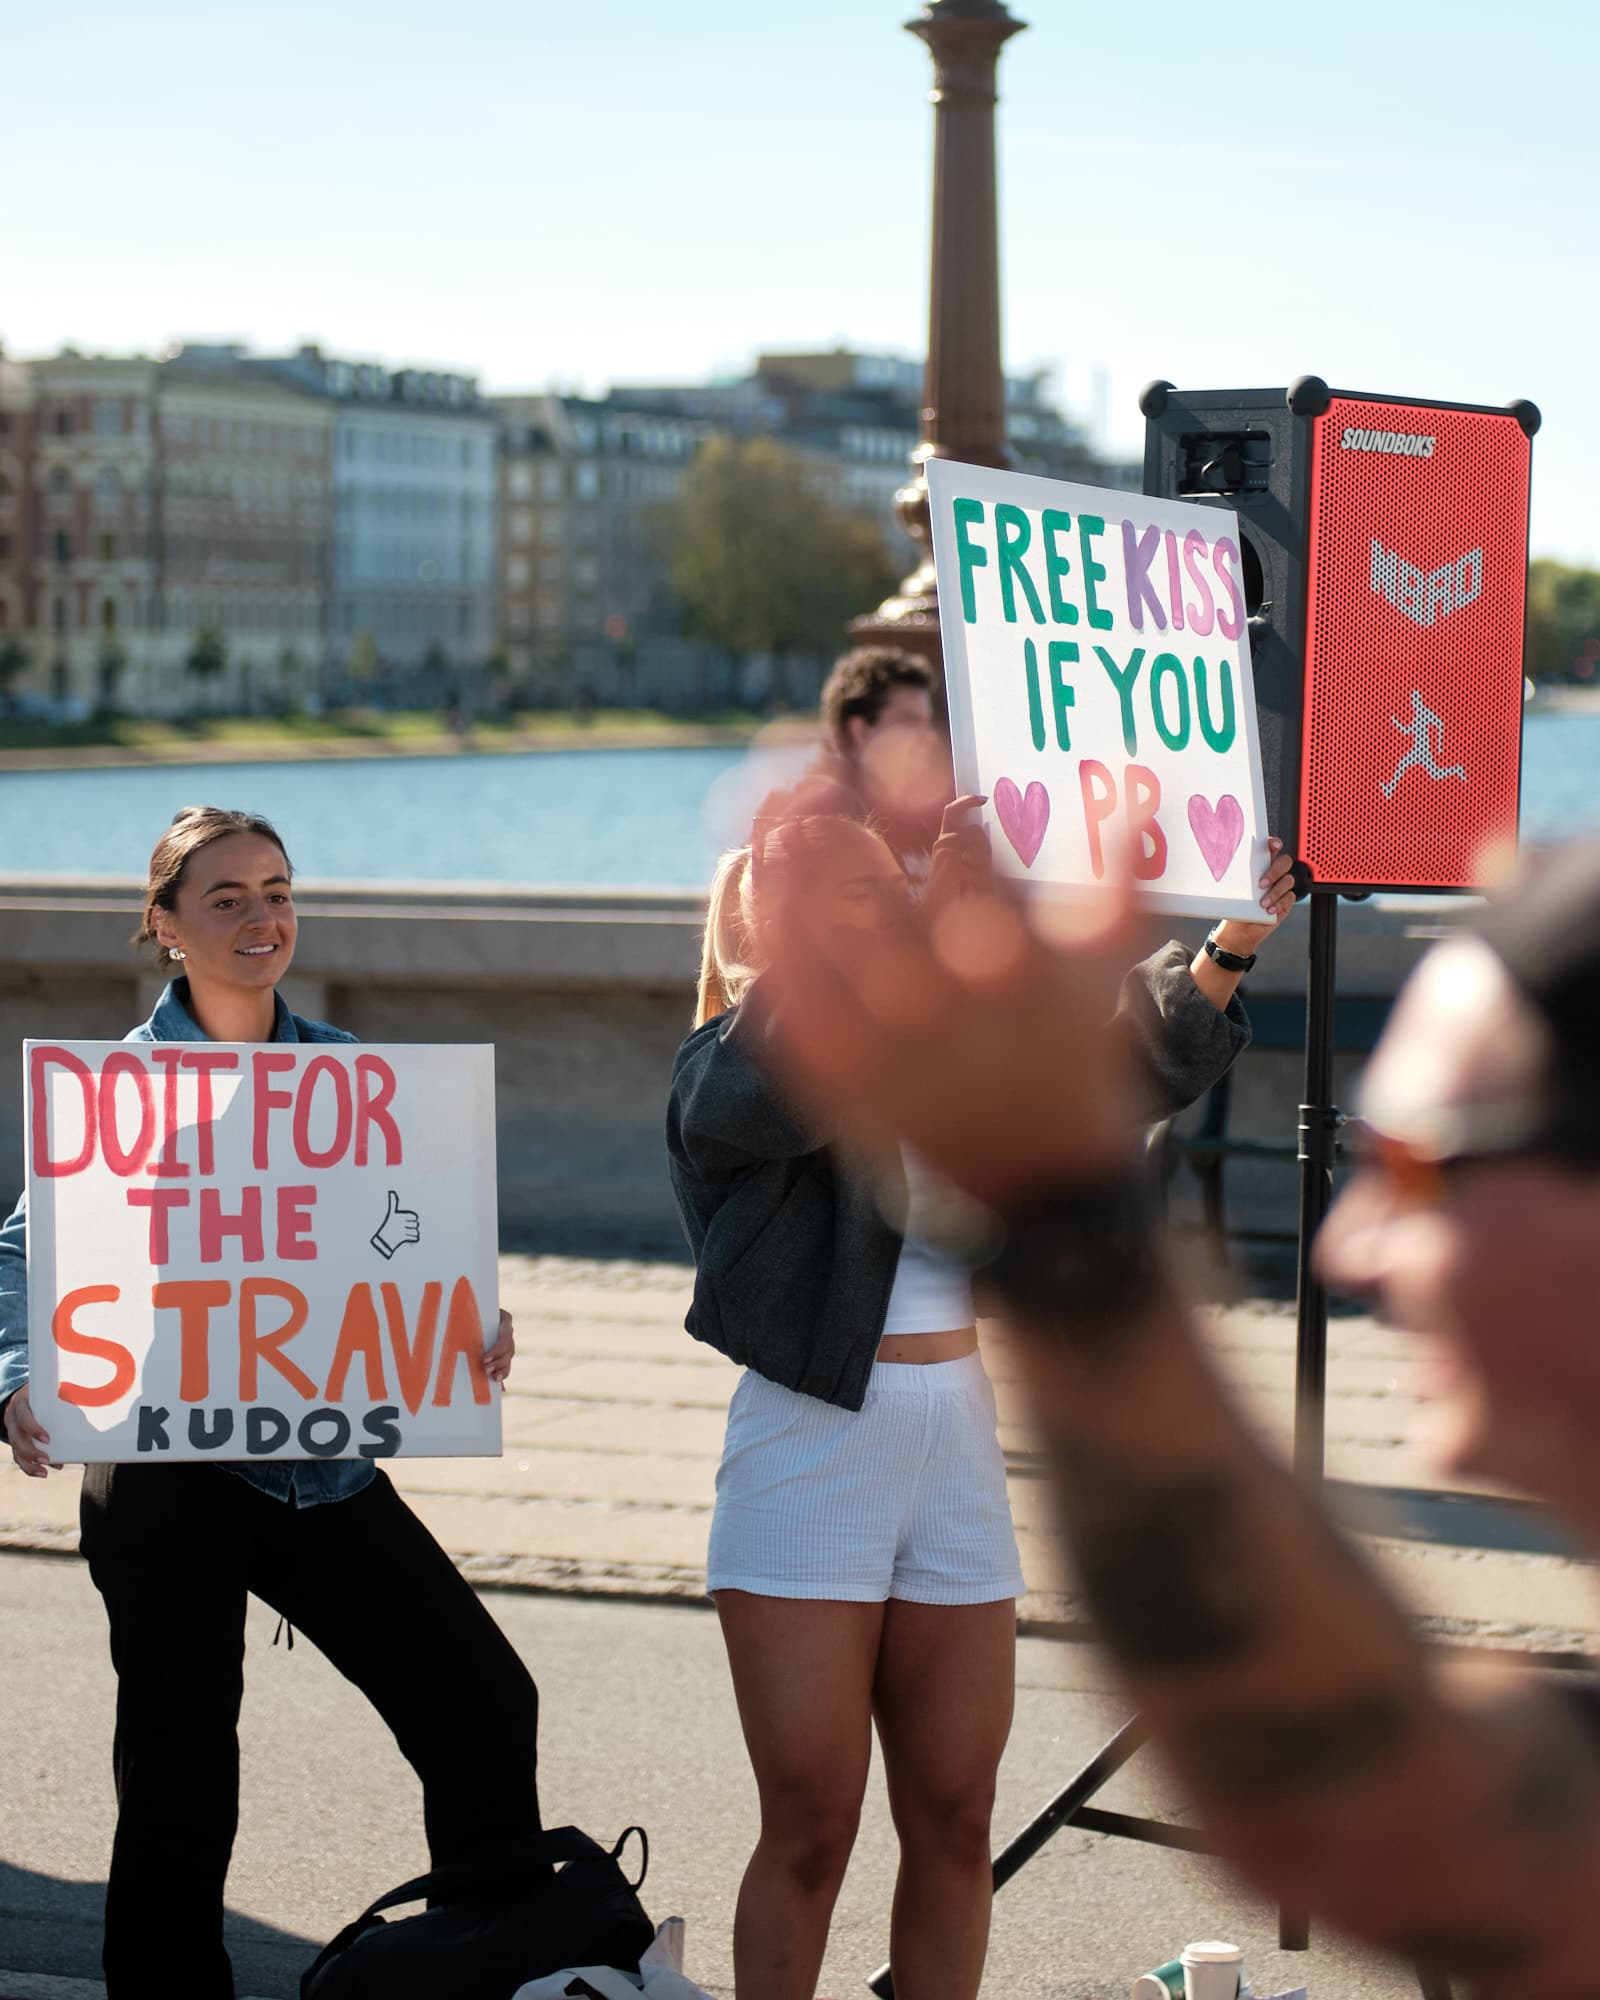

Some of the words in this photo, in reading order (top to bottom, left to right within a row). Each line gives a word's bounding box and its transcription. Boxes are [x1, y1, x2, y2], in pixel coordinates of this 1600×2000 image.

[1340, 427, 1436, 458] SOUNDBOKS
[953, 498, 1113, 630] FREE
[1121, 519, 1245, 641] KISS
[1024, 637, 1080, 752] IF
[1093, 645, 1236, 757] YOU
[1079, 760, 1167, 880] PB
[252, 1052, 402, 1170] FOR
[126, 1185, 317, 1265] THE
[51, 1276, 492, 1416] STRAVA
[137, 1405, 401, 1458] KUDOS
